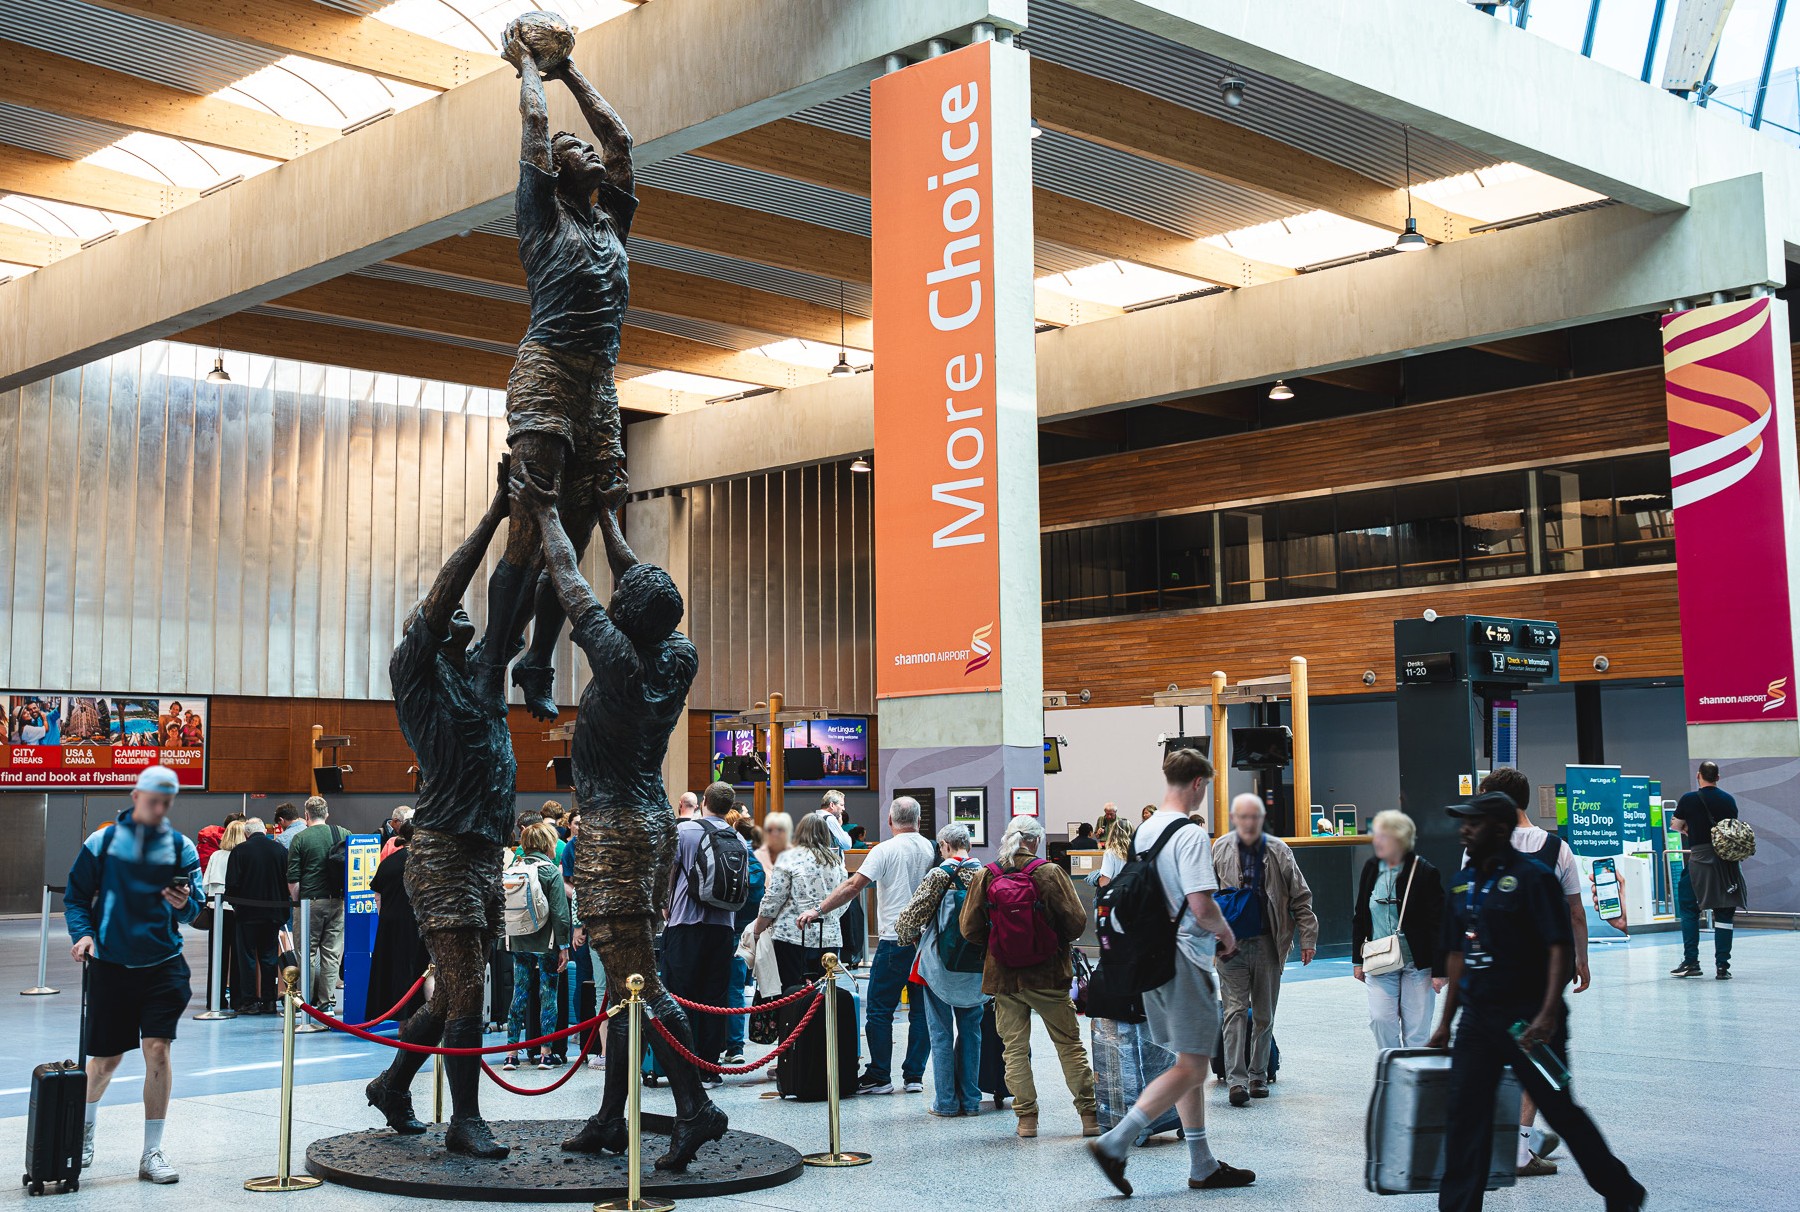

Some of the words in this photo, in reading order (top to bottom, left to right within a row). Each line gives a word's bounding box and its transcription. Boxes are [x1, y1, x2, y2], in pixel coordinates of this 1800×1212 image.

[927, 81, 982, 331] Choice
[932, 353, 985, 548] More
[1496, 634, 1511, 642] 11-20
[894, 652, 936, 666] shannon
[936, 649, 971, 662] AIRPORT
[1405, 667, 1427, 676] 11-20
[1244, 686, 1251, 696] 11
[1049, 697, 1059, 706] 12
[1699, 696, 1737, 705] shannon
[1737, 694, 1768, 703] AIRPORT
[742, 716, 748, 724] 15
[812, 711, 821, 720] 14
[837, 726, 855, 735] Lingus
[13, 749, 35, 757] CITY
[65, 749, 84, 757] USA
[86, 749, 93, 757] &
[114, 750, 156, 758] CAMPING
[160, 750, 201, 758] HOLIDAYS
[0, 772, 23, 782] find
[25, 772, 46, 782] and
[49, 772, 75, 782] book
[79, 773, 91, 782] at
[93, 772, 138, 784] flyshann
[1572, 797, 1601, 813] Express
[1573, 814, 1590, 826] Bag
[1591, 814, 1614, 826] Drop
[1623, 811, 1634, 821] Bag
[1633, 811, 1647, 821] Drop
[1601, 830, 1617, 838] Lingus
[1589, 839, 1597, 847] tag
[1597, 839, 1609, 847] your
[1609, 839, 1620, 847] bag.
